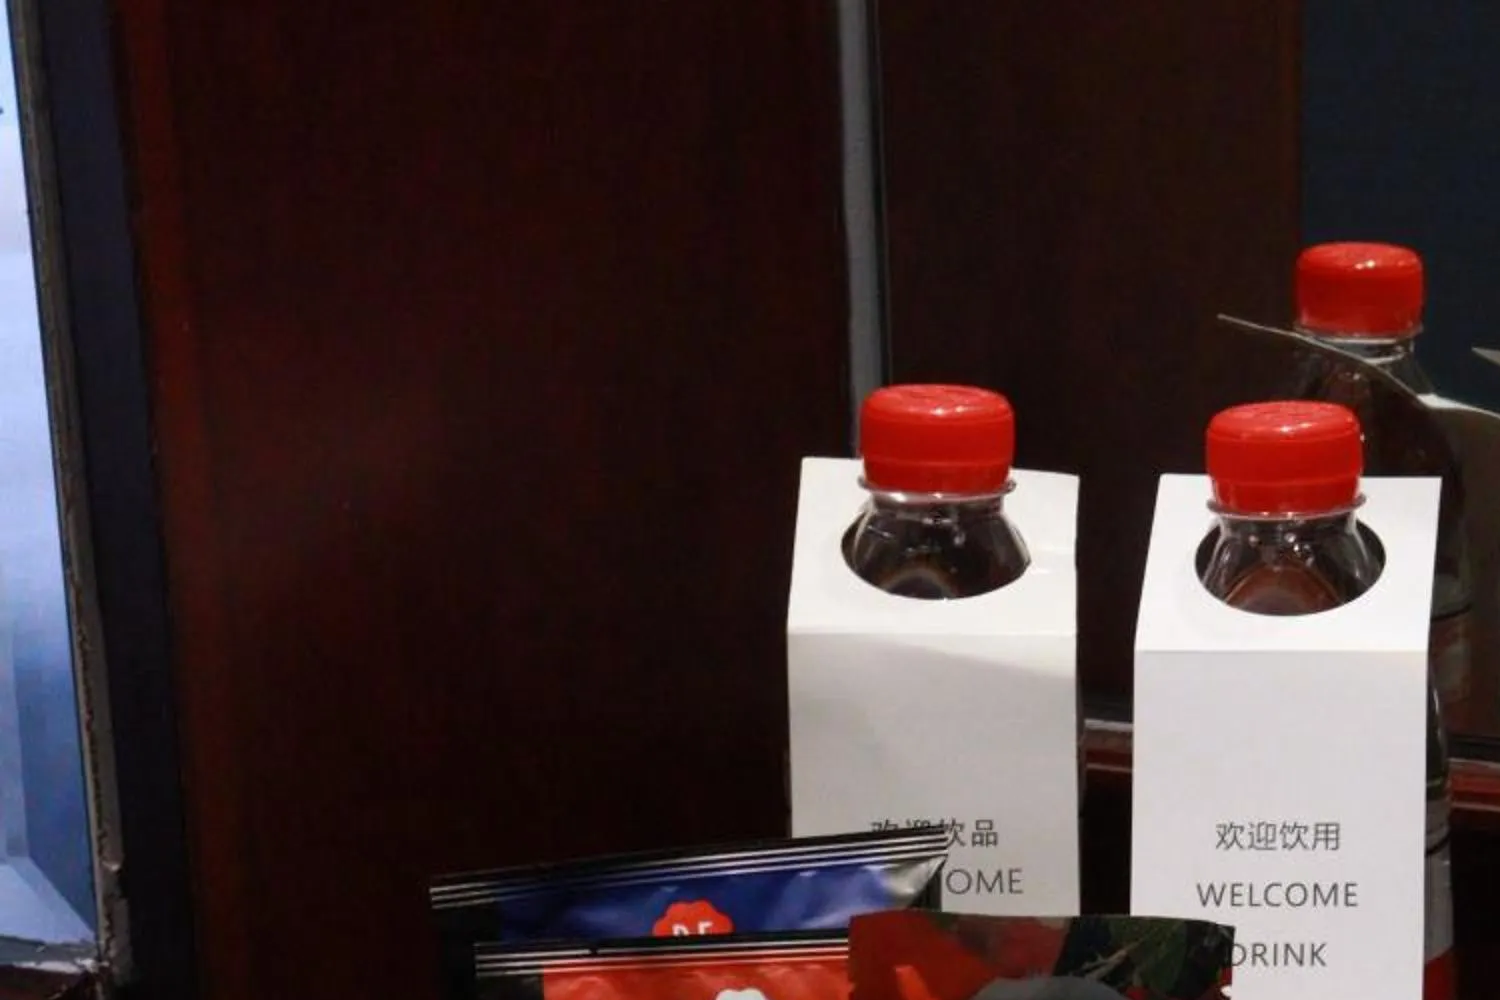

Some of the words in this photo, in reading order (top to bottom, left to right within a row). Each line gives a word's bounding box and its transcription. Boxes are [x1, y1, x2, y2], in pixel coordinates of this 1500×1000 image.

[1215, 821, 1341, 851] 欢迎饮用
[1196, 882, 1359, 908] WELCOME
